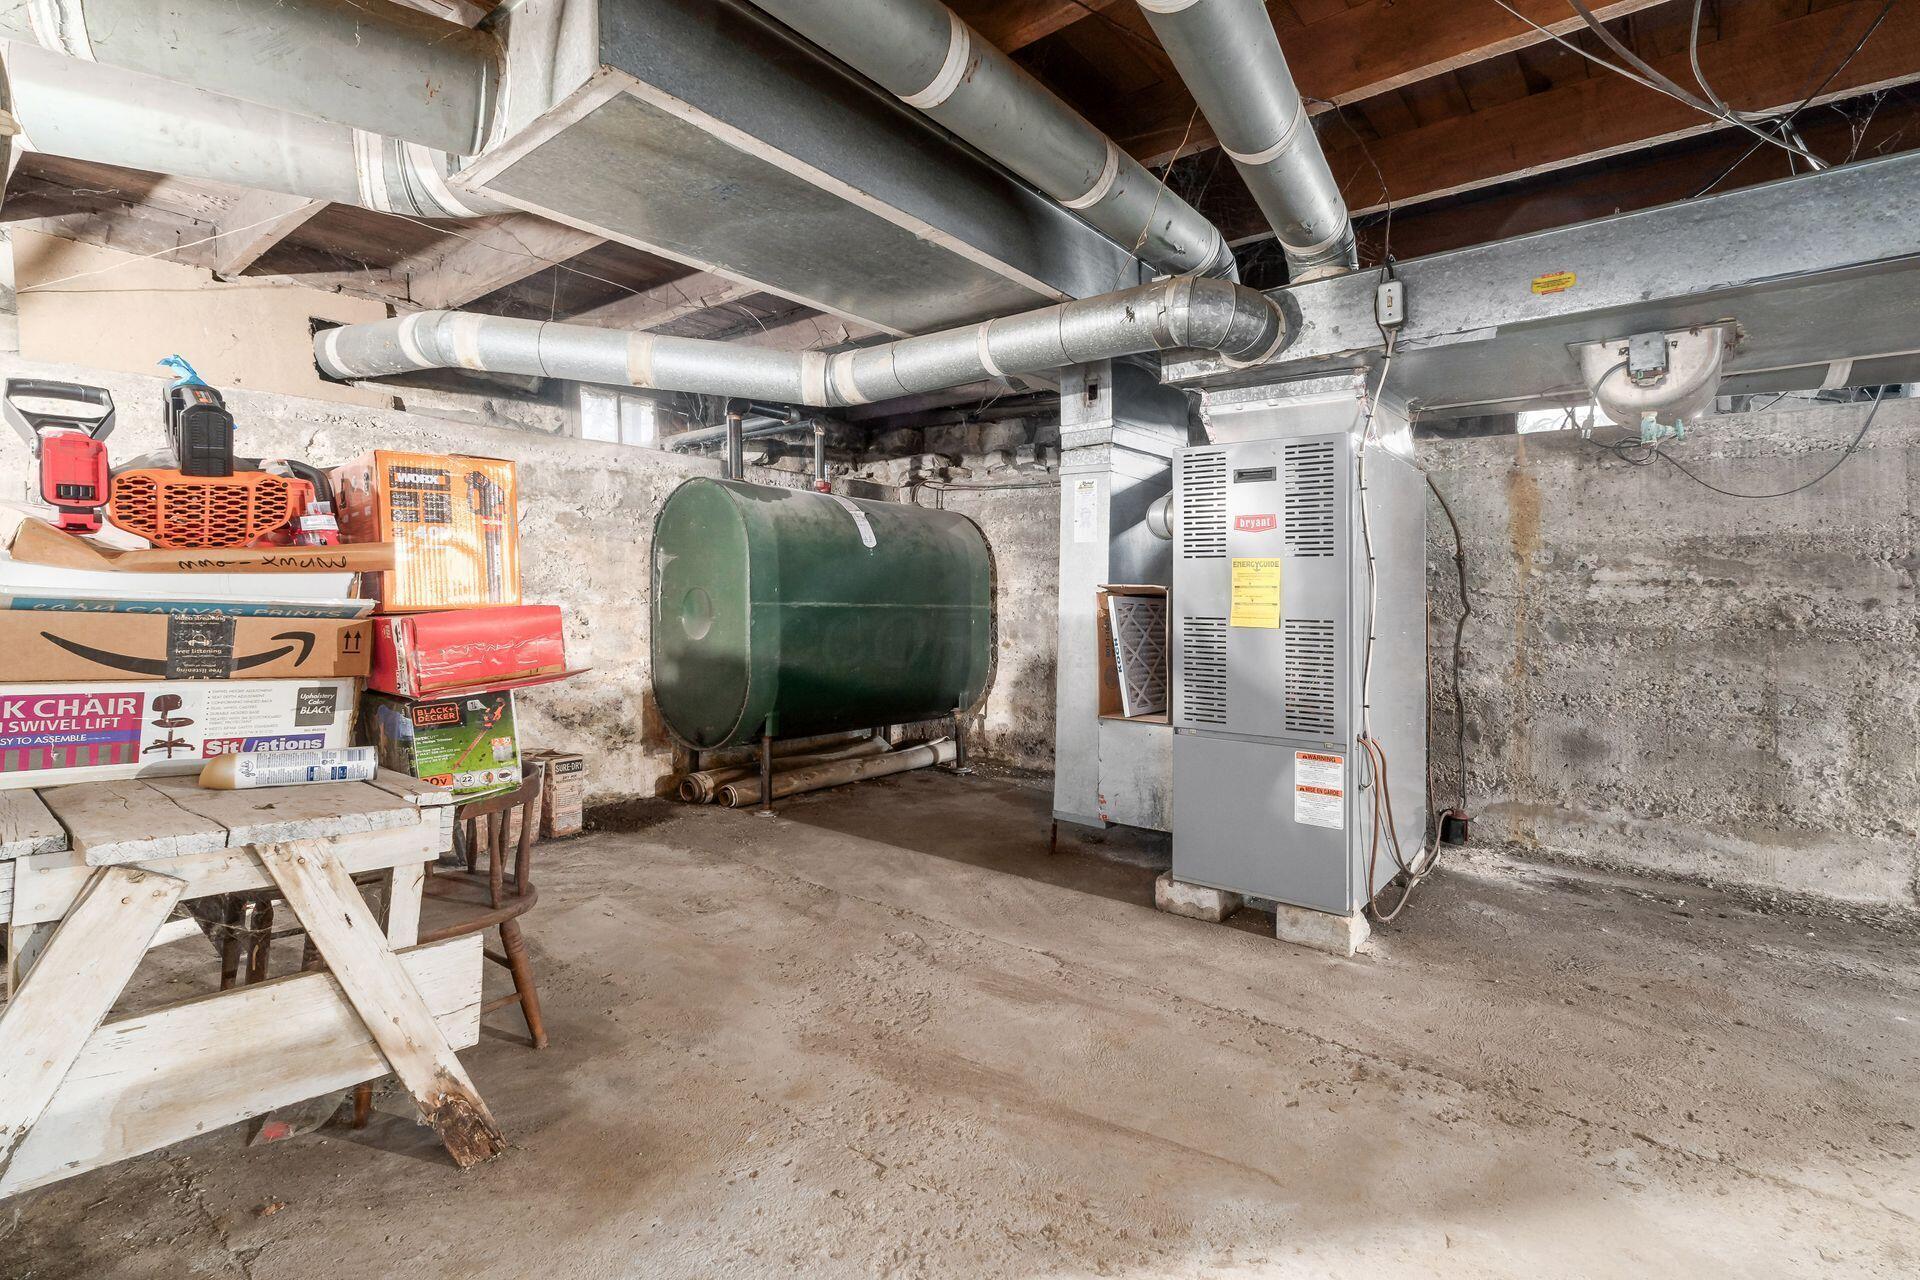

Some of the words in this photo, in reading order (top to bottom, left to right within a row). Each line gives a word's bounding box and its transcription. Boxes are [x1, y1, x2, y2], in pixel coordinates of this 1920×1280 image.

[396, 472, 439, 484] WORX
[1240, 518, 1271, 529] bryant
[252, 608, 345, 618] PRINTS
[1113, 638, 1122, 672] KOCH
[300, 693, 335, 701] Upholstery
[33, 697, 137, 718] CHAIR
[300, 706, 333, 715] BLACK
[417, 713, 456, 723] DECKER
[8, 719, 80, 733] SWIVEL
[85, 717, 121, 730] LIFT
[16, 736, 32, 745] TO
[34, 733, 87, 744] ASSEMBLE
[1307, 754, 1336, 763] WARNING
